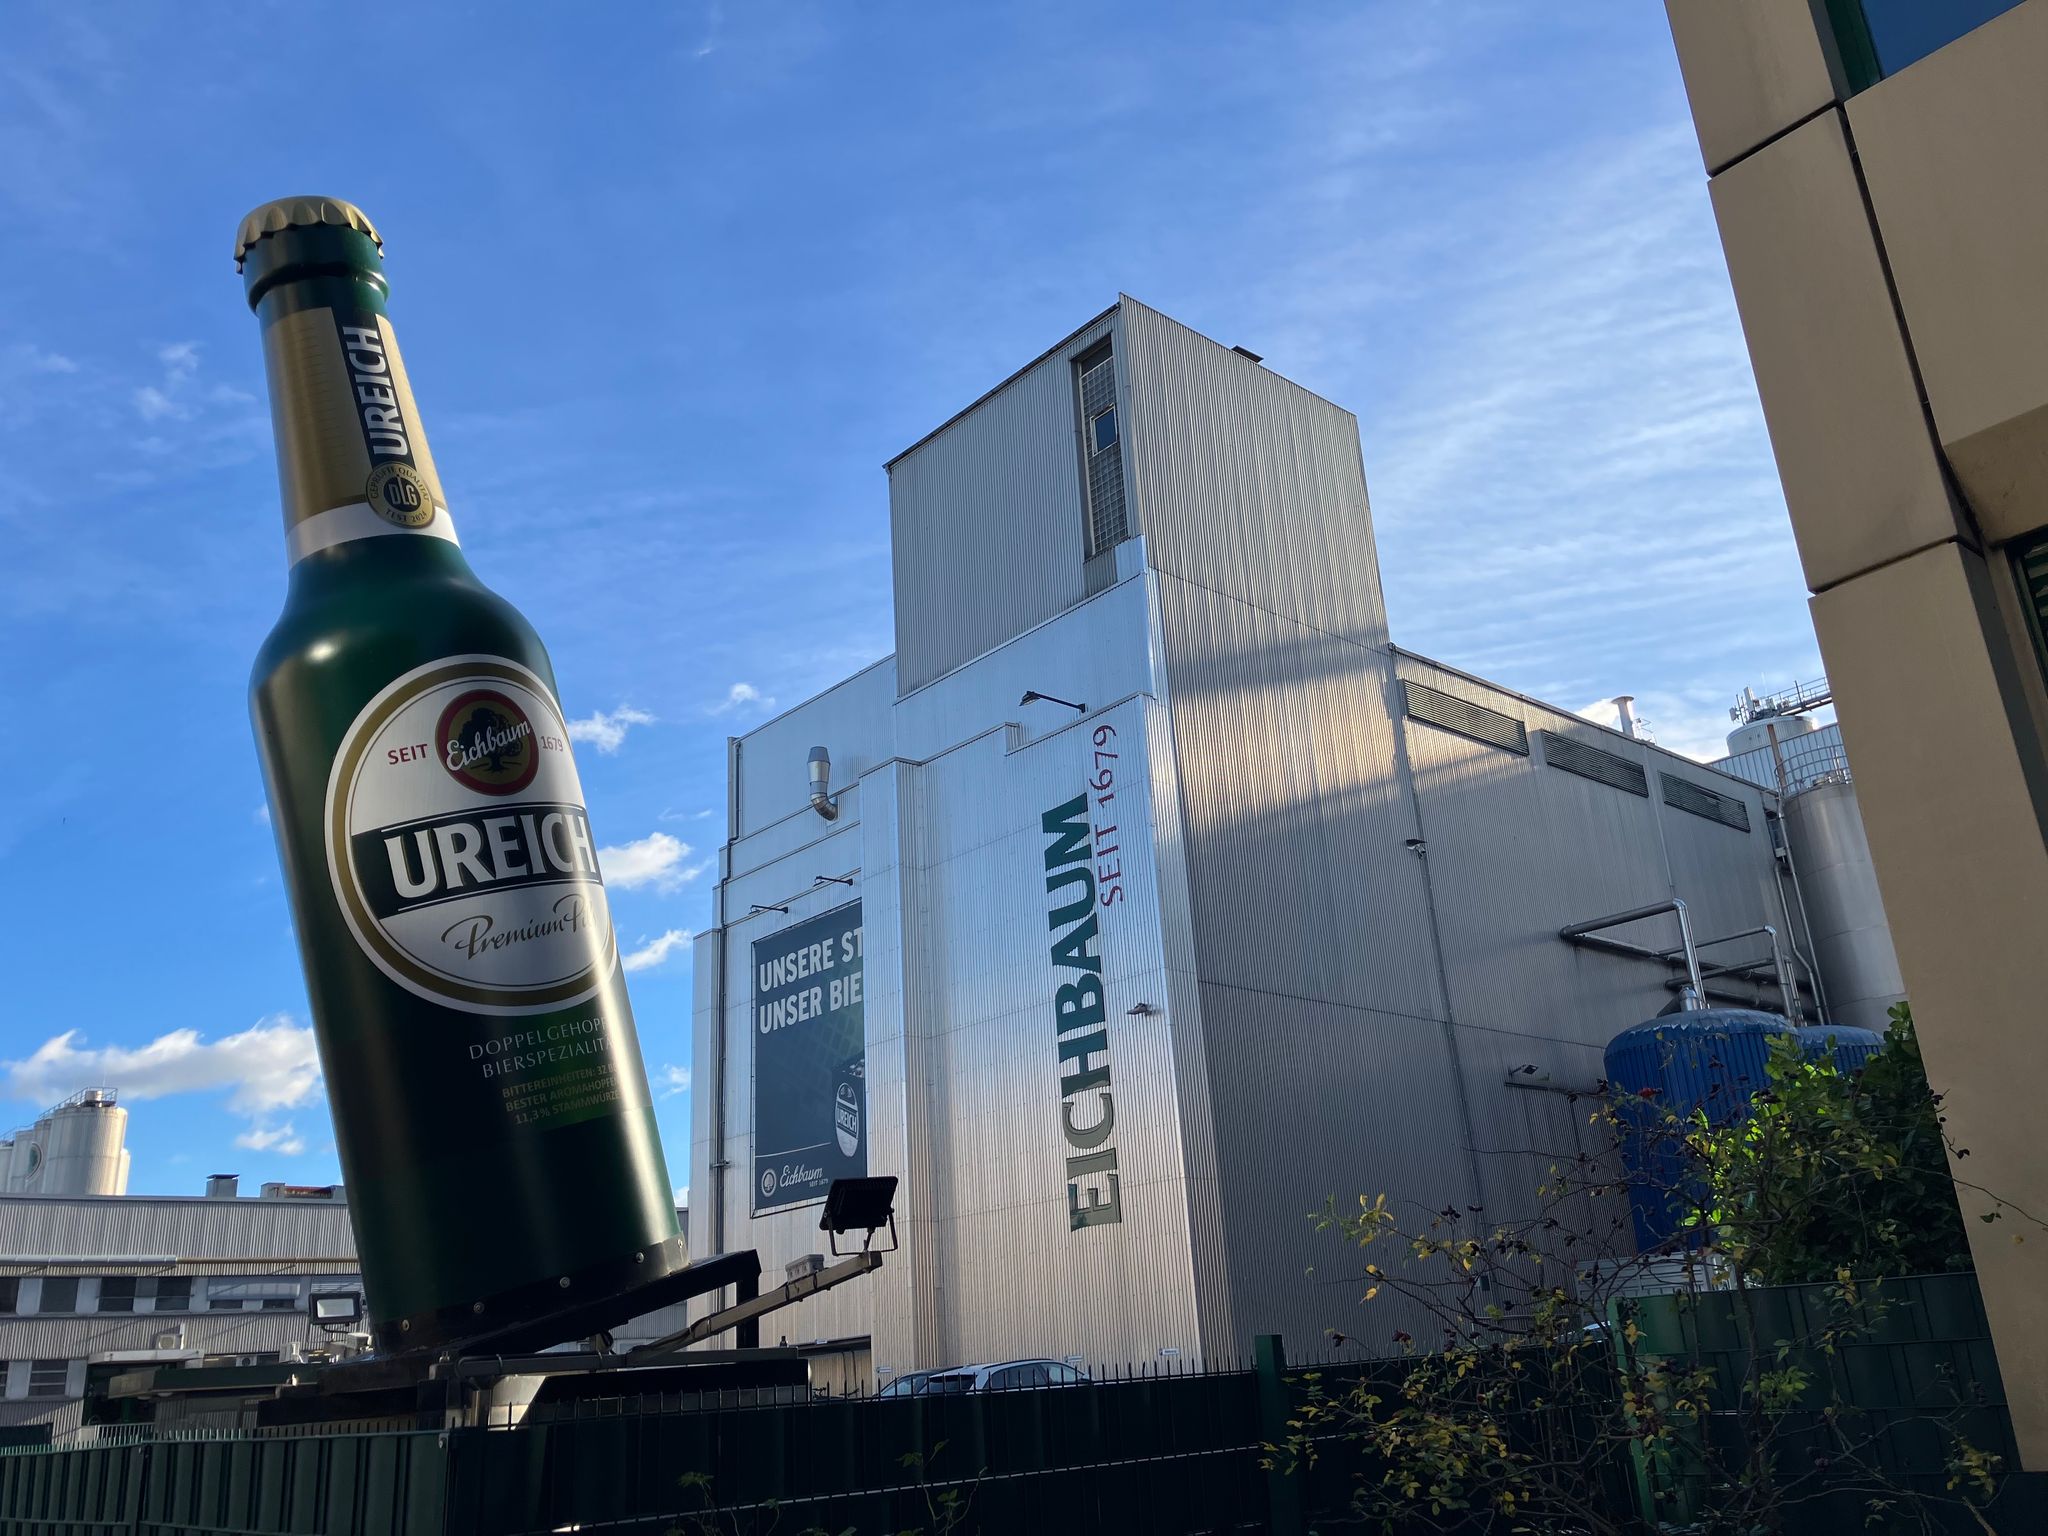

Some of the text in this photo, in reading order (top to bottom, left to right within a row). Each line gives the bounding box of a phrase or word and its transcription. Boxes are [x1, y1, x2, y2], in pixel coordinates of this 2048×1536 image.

[342, 326, 408, 456] UREICH
[388, 476, 418, 506] DLG
[387, 735, 564, 765] SEIT 1679
[446, 718, 531, 771] Eichbaum
[1089, 724, 1124, 907] SEIT 1679
[383, 812, 597, 899] UREICH
[440, 914, 564, 961] Premium
[760, 937, 835, 993] UNSERE
[760, 986, 823, 1034] UNSER
[1041, 792, 1122, 1232] EICHBAUM
[502, 1067, 596, 1098] BITTEREINHEITEN:
[505, 1093, 548, 1112] BESTER
[514, 1109, 539, 1125] 11,3
[540, 1107, 551, 1118] %
[779, 1164, 823, 1188] Eichbaum
